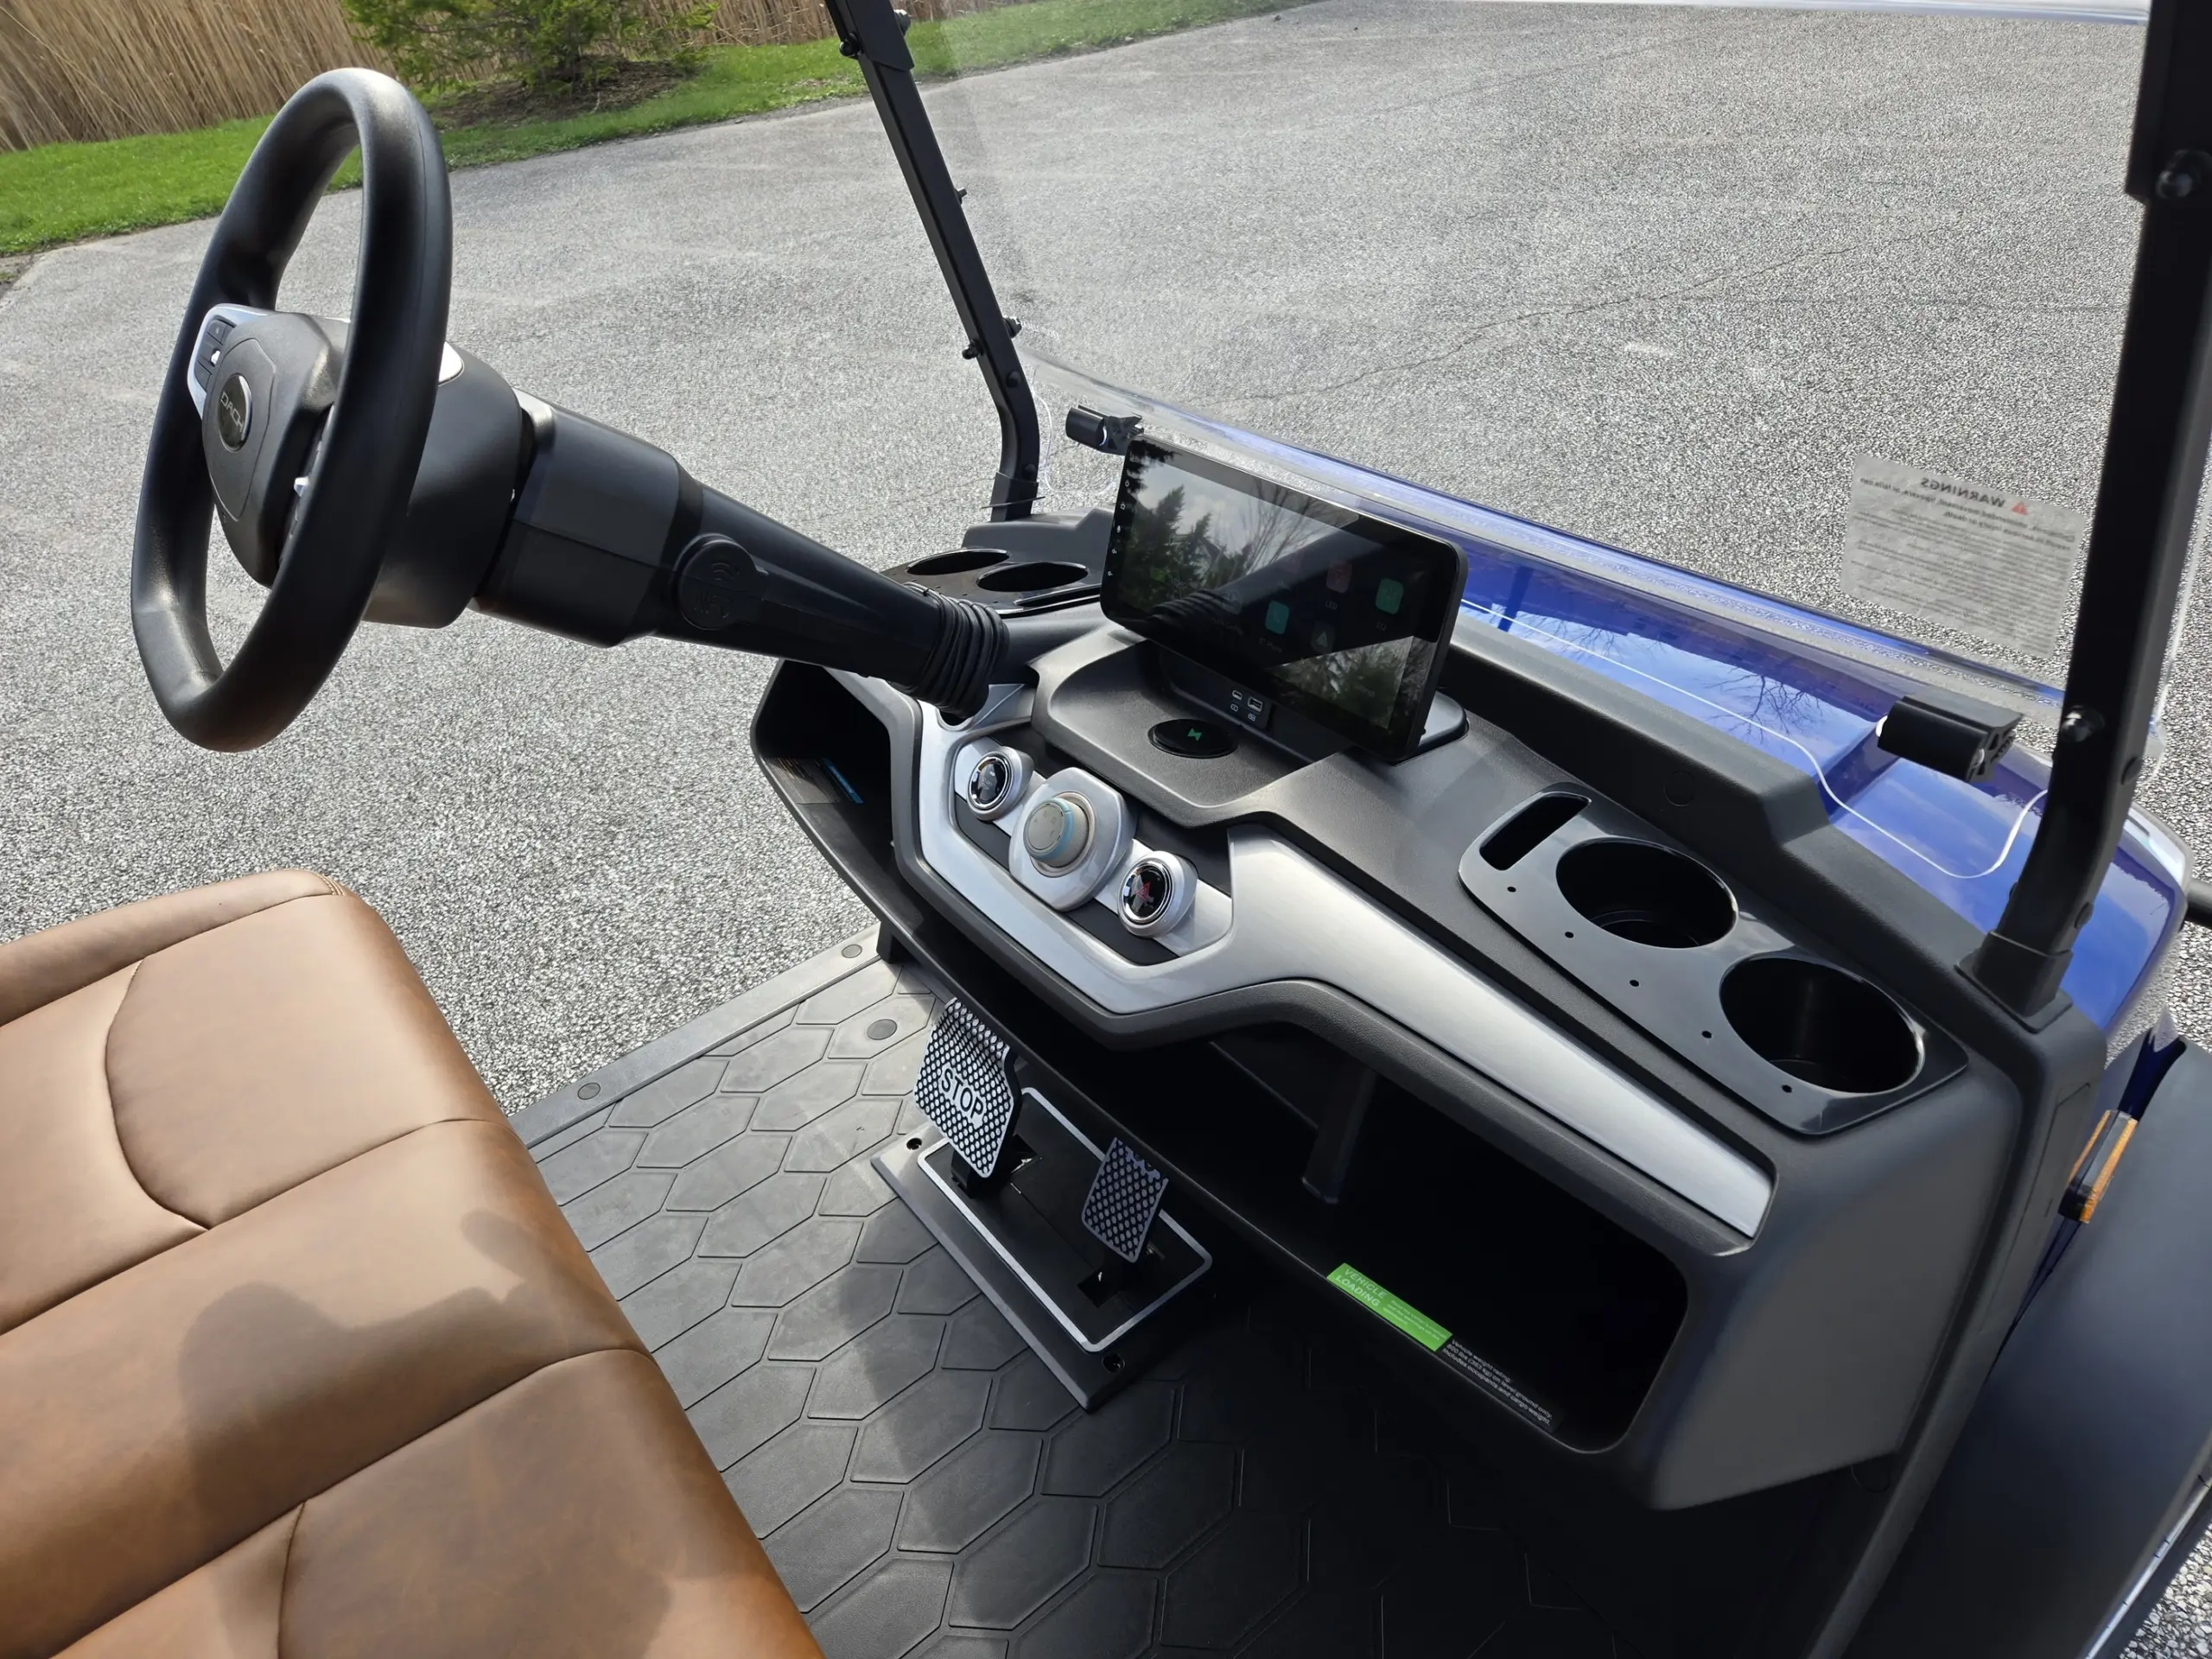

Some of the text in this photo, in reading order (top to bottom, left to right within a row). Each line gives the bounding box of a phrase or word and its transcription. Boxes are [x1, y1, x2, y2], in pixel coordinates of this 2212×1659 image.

[941, 1068, 985, 1118] STOP
[1336, 1274, 1381, 1306] LOADING
[1344, 1268, 1388, 1300] VEHICLE
[1452, 1338, 1473, 1357] Vehicle
[1466, 1365, 1498, 1389] occupants
[1497, 1386, 1511, 1397] and
[1510, 1395, 1529, 1410] cargo
[1515, 1391, 1539, 1408] ground
